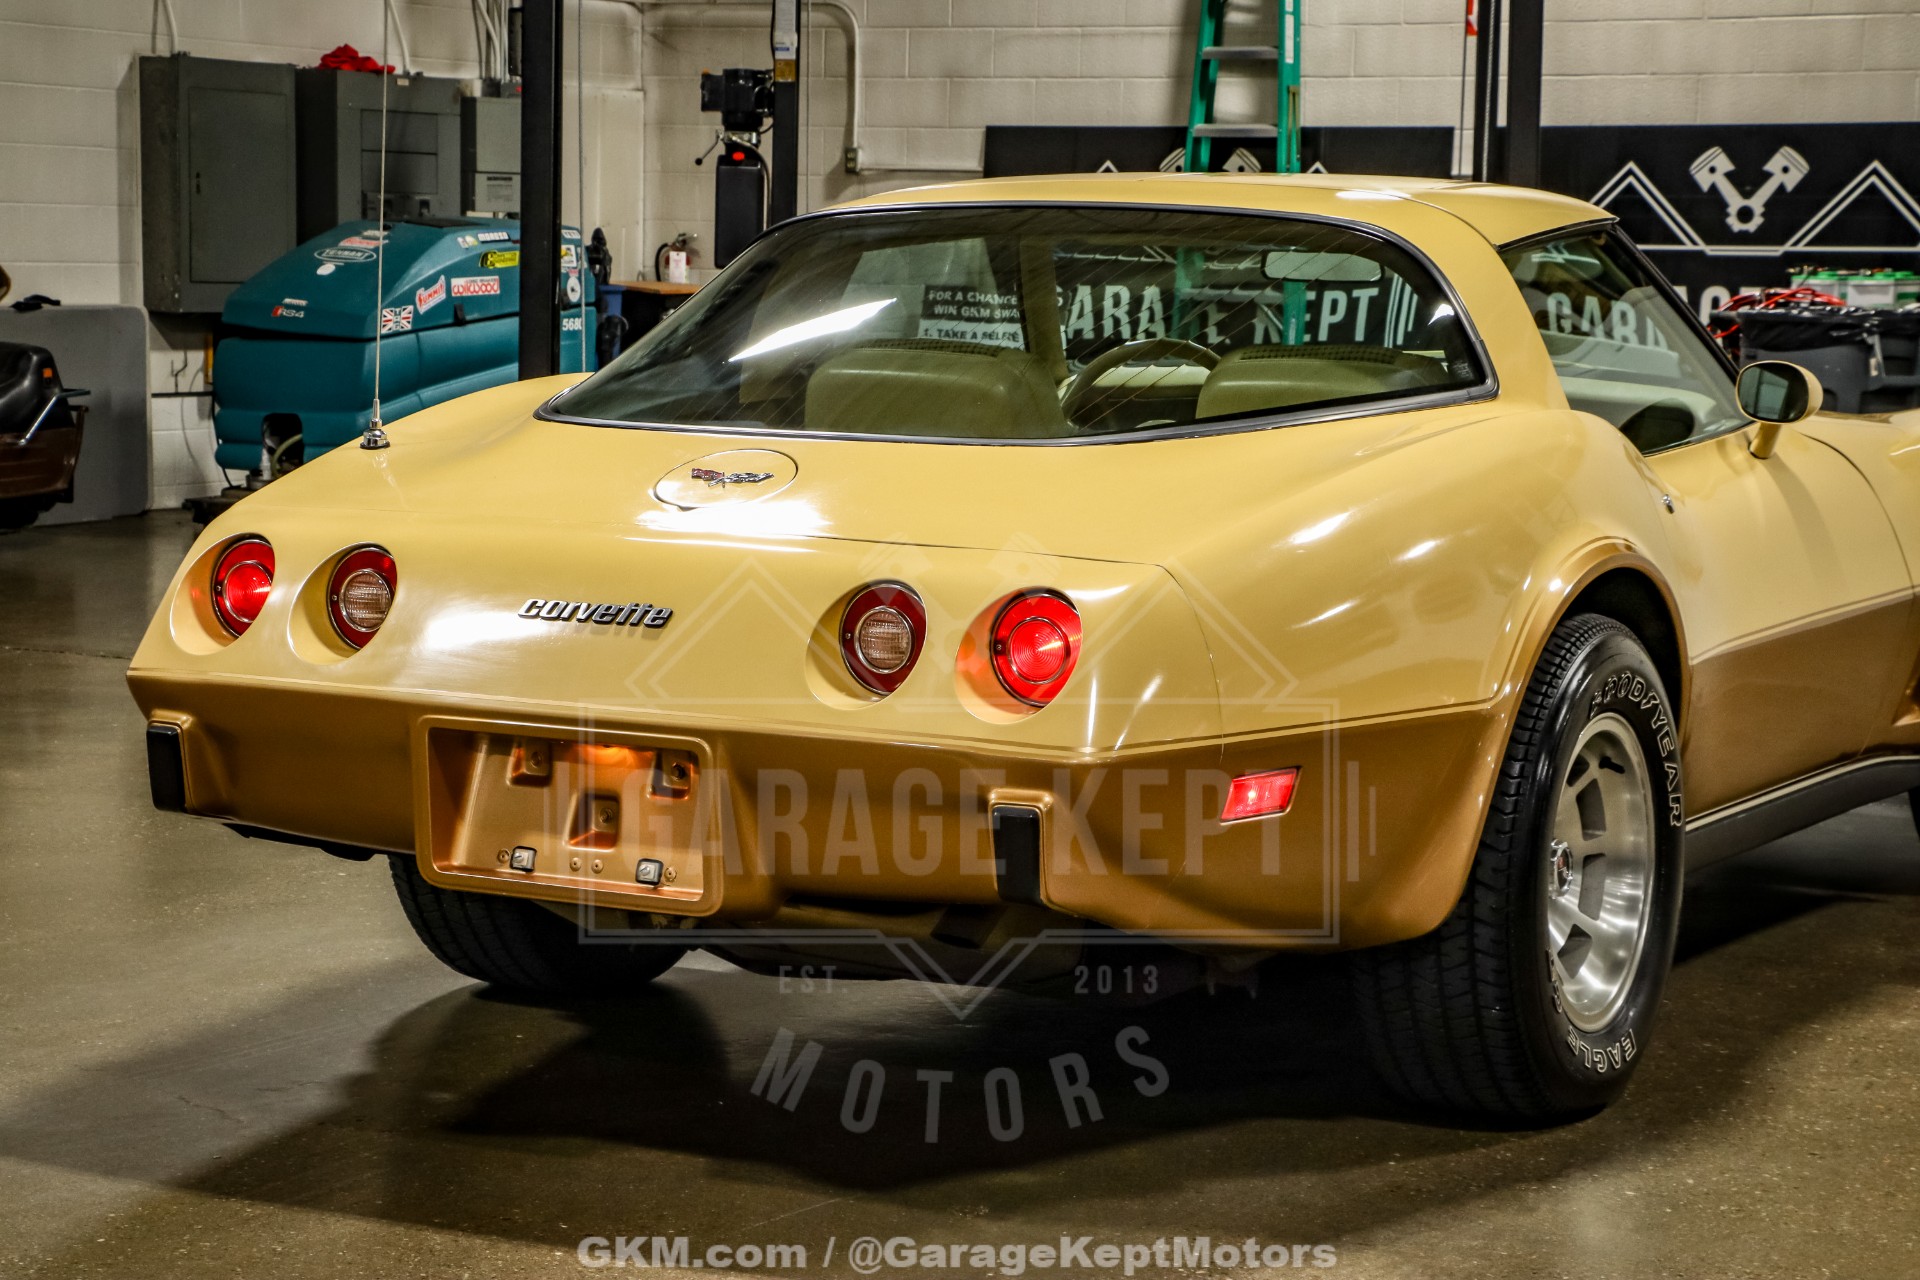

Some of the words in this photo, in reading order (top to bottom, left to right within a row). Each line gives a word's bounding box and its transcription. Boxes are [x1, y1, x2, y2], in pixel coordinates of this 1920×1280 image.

[928, 290, 951, 300] FOR
[955, 291, 964, 301] A
[934, 304, 957, 315] WIN
[961, 307, 991, 318] GKM
[937, 329, 967, 339] TAKE
[970, 331, 978, 340] A
